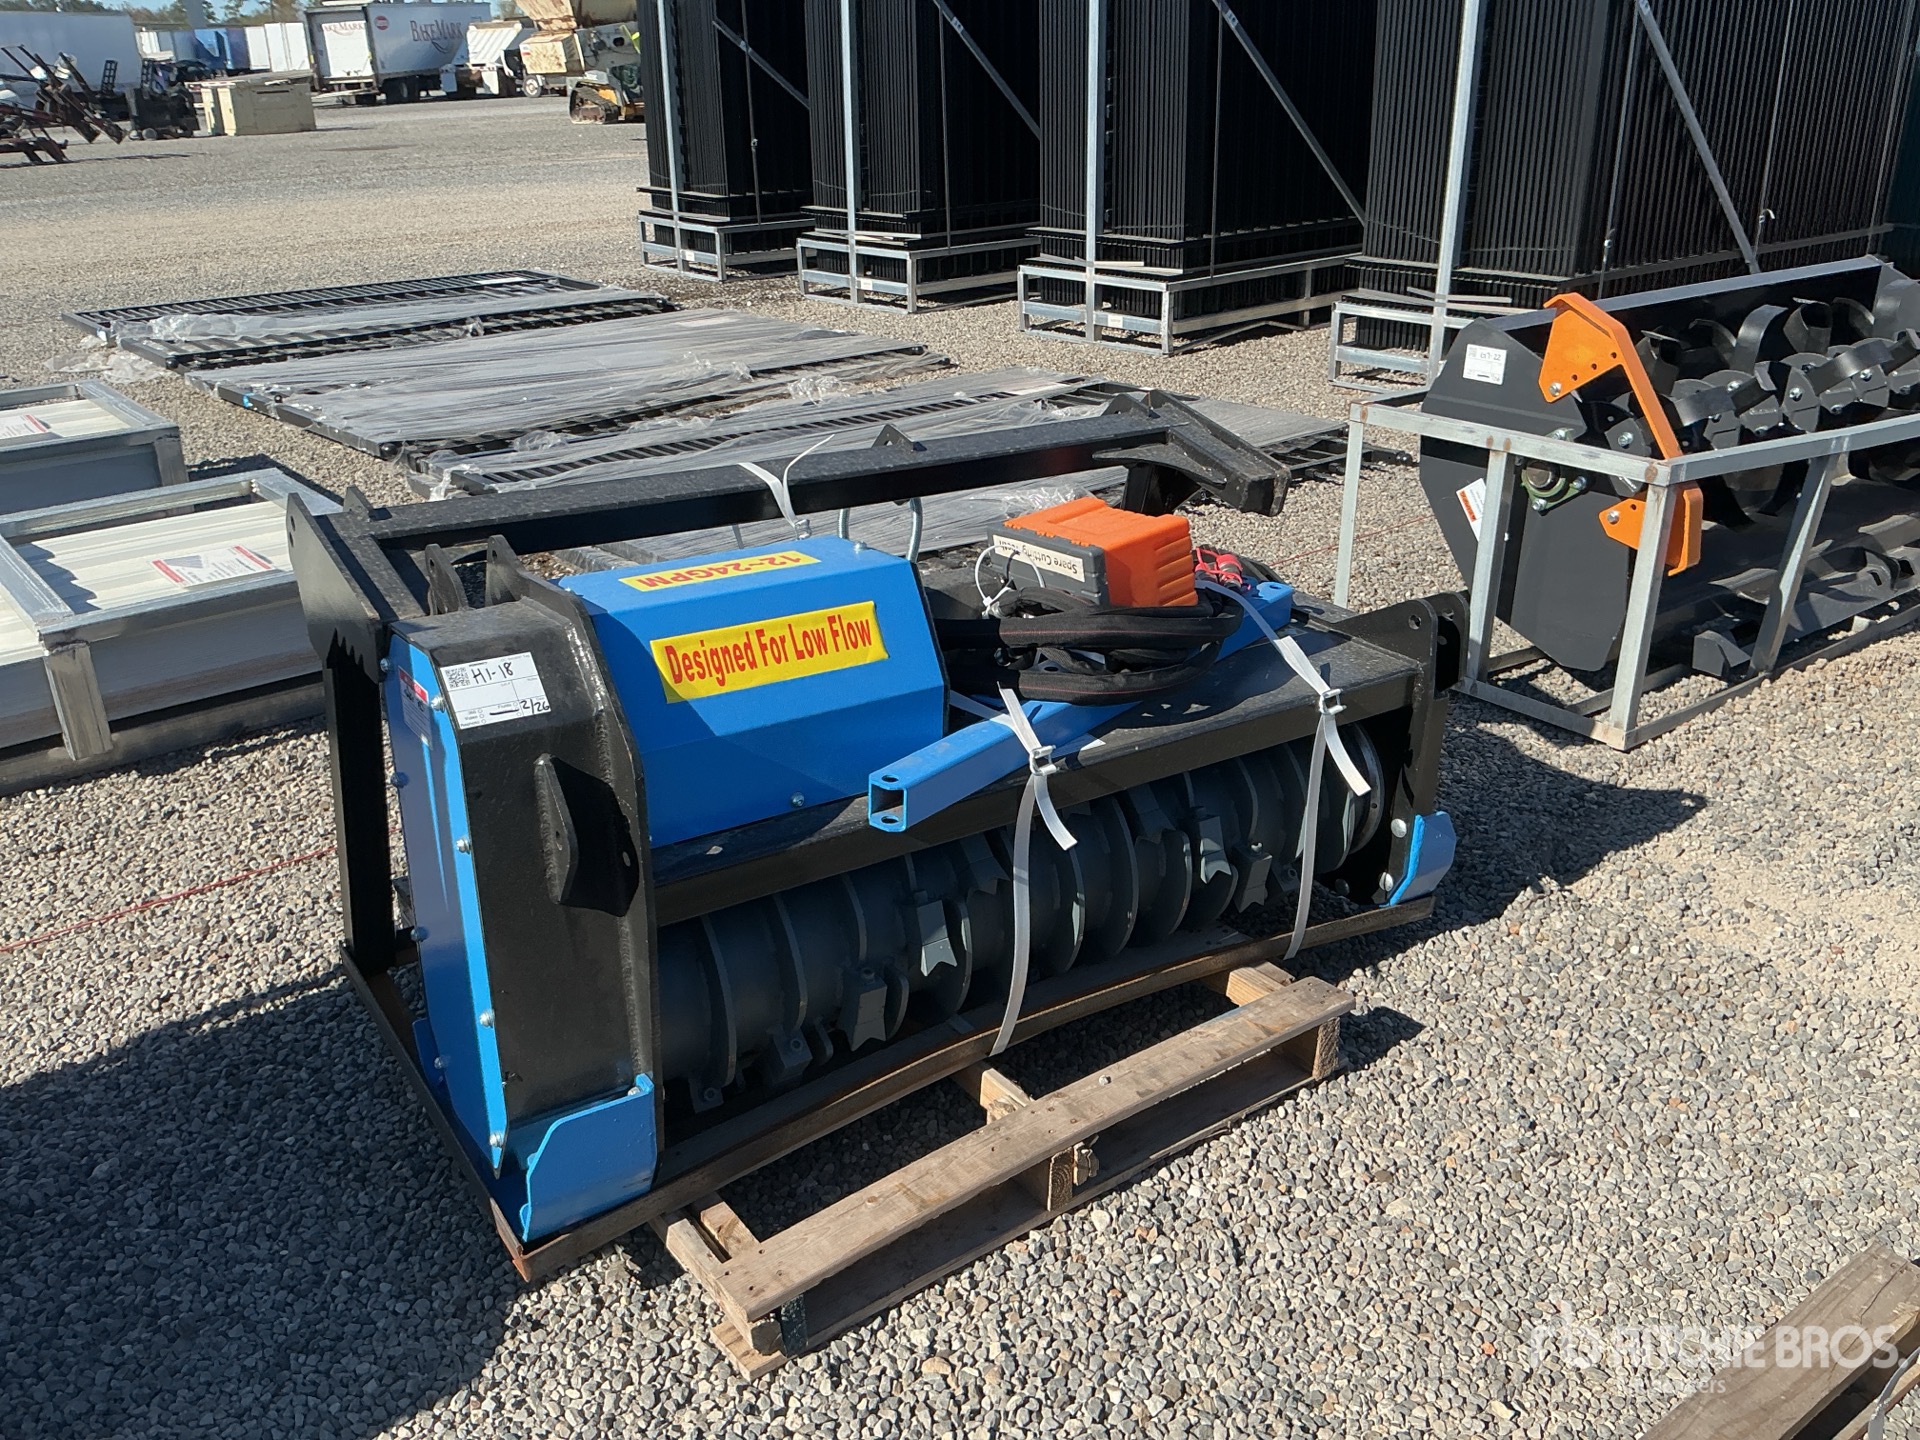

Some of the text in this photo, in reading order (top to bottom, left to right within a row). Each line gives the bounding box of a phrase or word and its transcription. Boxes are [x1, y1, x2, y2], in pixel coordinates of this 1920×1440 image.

[1053, 559, 1078, 575] Spare
[664, 614, 873, 687] Designed For Low Flow
[520, 698, 550, 716] 2/26
